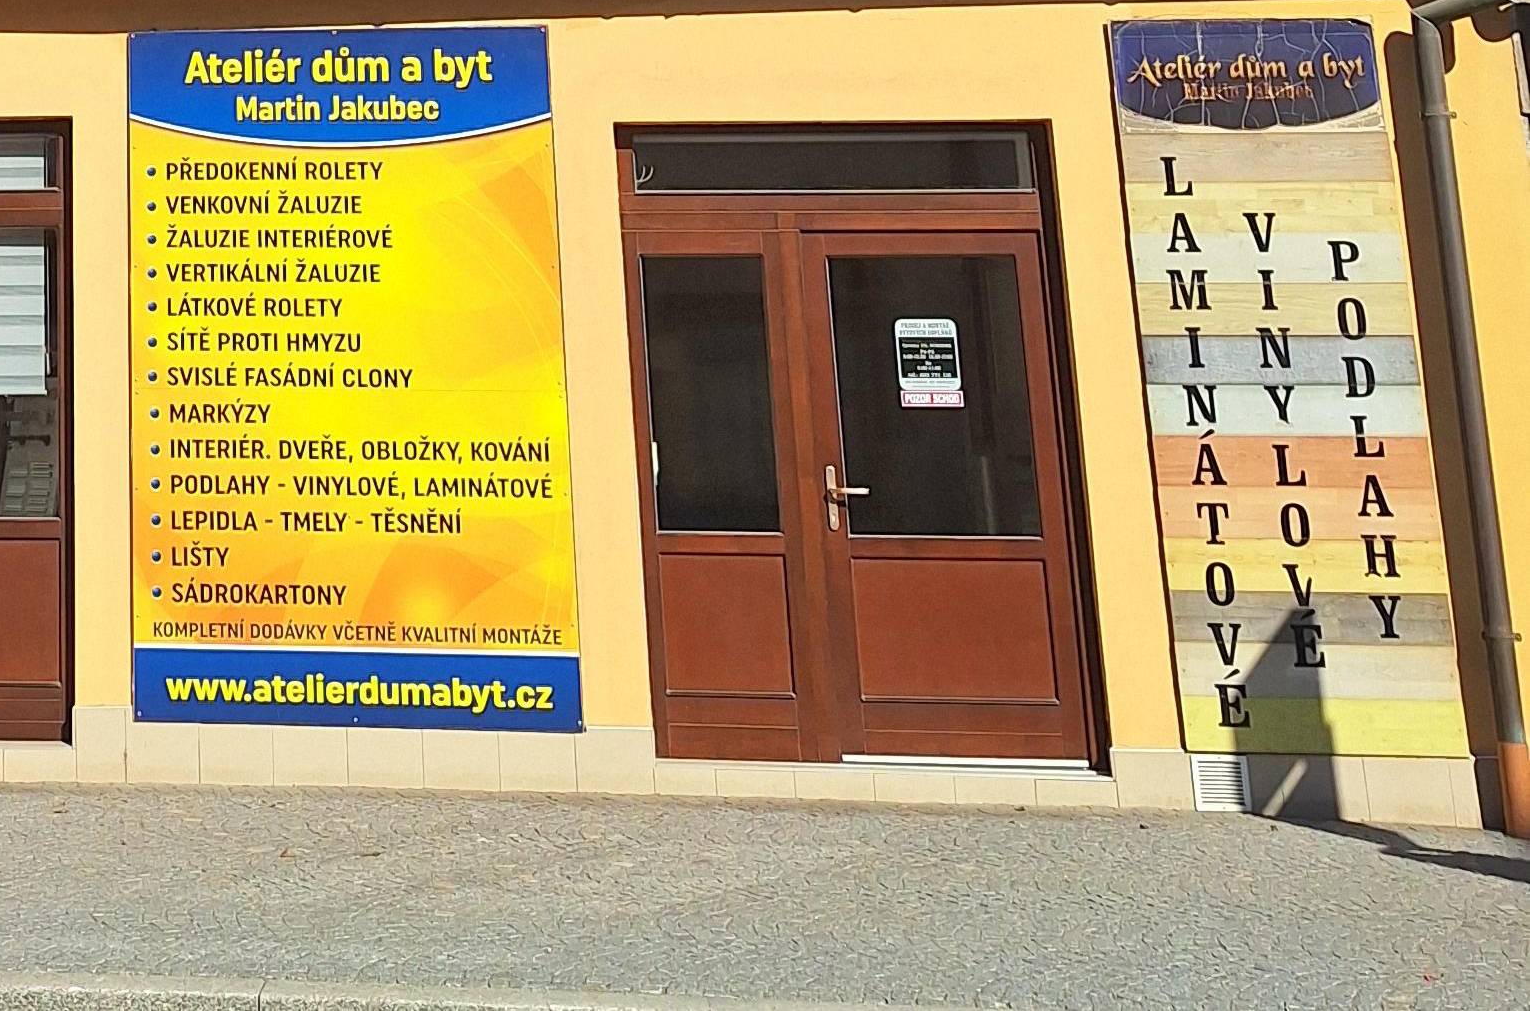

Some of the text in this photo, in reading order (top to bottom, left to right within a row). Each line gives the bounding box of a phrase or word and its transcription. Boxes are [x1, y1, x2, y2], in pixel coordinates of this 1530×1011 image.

[184, 47, 492, 89] Ateliér dům a byt
[1127, 52, 1365, 89] Ateliér dům a byt
[236, 94, 440, 122] Martin Jakubec
[166, 156, 384, 181] PŘEDOKENNÍ ROLETY
[166, 189, 362, 214] VENKOVNÍ ŽALUZIE
[166, 223, 394, 249] ŽALUZIE INTERIÉROVÉ
[166, 257, 381, 283] VERTIKÁLNÍ ŽALUZIE
[166, 291, 343, 317] LÁTKOVÉ ROLETY
[167, 327, 362, 353] SÍTĚ PROTI HMYZU
[166, 361, 413, 389] SVISLÉ FASÁDNÍ CLONY
[170, 399, 271, 425] MARKÝZY
[170, 434, 550, 465] INTERIÉR. DVEŘE, OBLOŽKY, KOVÁNÍ
[1160, 156, 1251, 728] LAMINÁTOVÉ
[1242, 212, 1326, 669] VINYLOVÉ
[1327, 240, 1401, 639] PODLAHY
[170, 475, 270, 496] PODLAHY
[293, 470, 406, 501] VINYLOVÉ,
[414, 472, 553, 500] LAMINÁTOVÉ
[170, 509, 258, 532] LEPIDLA
[280, 511, 347, 534] TMELY
[372, 507, 462, 535] TĚSNĚNÍ
[170, 541, 230, 568] LIŠTY
[171, 577, 347, 606] SÁDROKARTONY
[153, 618, 562, 646] KOMPLETNÍ DODÁVKY VČETNĚ KVALITNÍ MONTÁŽE
[165, 673, 555, 714] www.atelierdumabyt.cz
